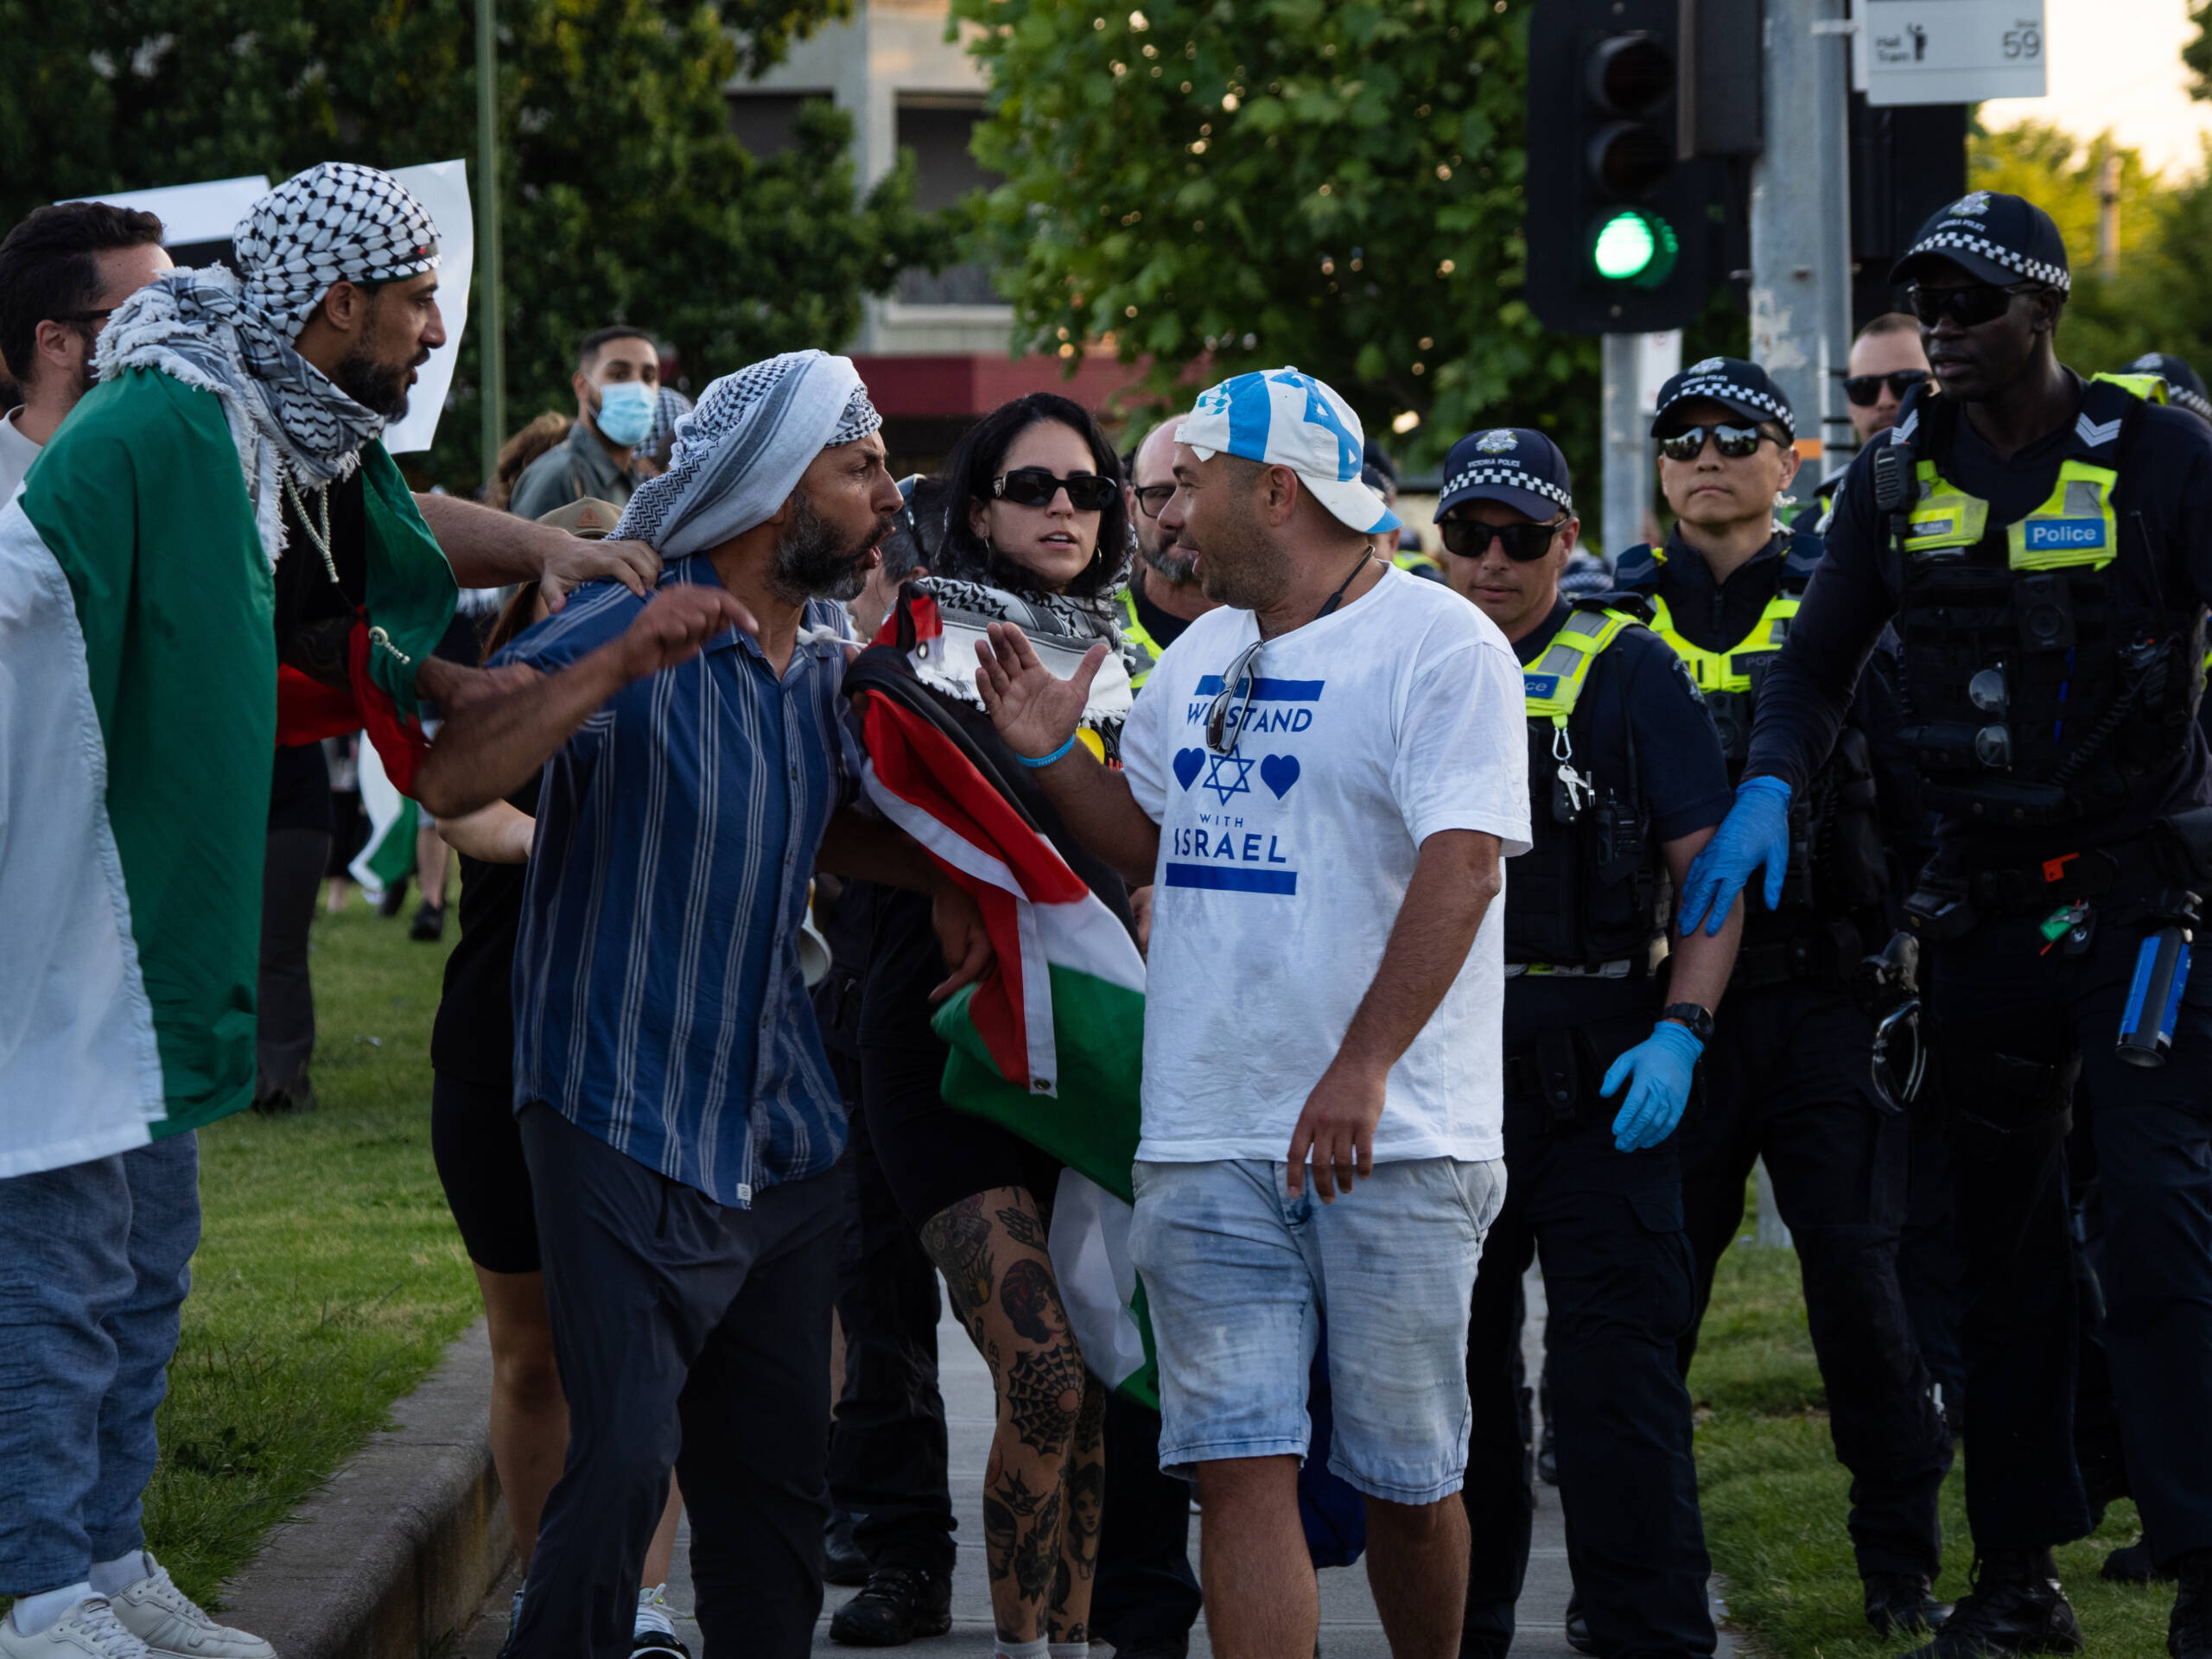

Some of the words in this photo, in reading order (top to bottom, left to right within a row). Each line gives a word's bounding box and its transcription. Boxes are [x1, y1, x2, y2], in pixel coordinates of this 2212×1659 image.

[2002, 29, 2041, 59] 59
[1497, 458, 1521, 468] POLICE
[2032, 526, 2096, 543] Police
[1225, 705, 1313, 733] STAND
[1199, 813, 1244, 828] WITH
[1174, 827, 1287, 863] ISRAEL
